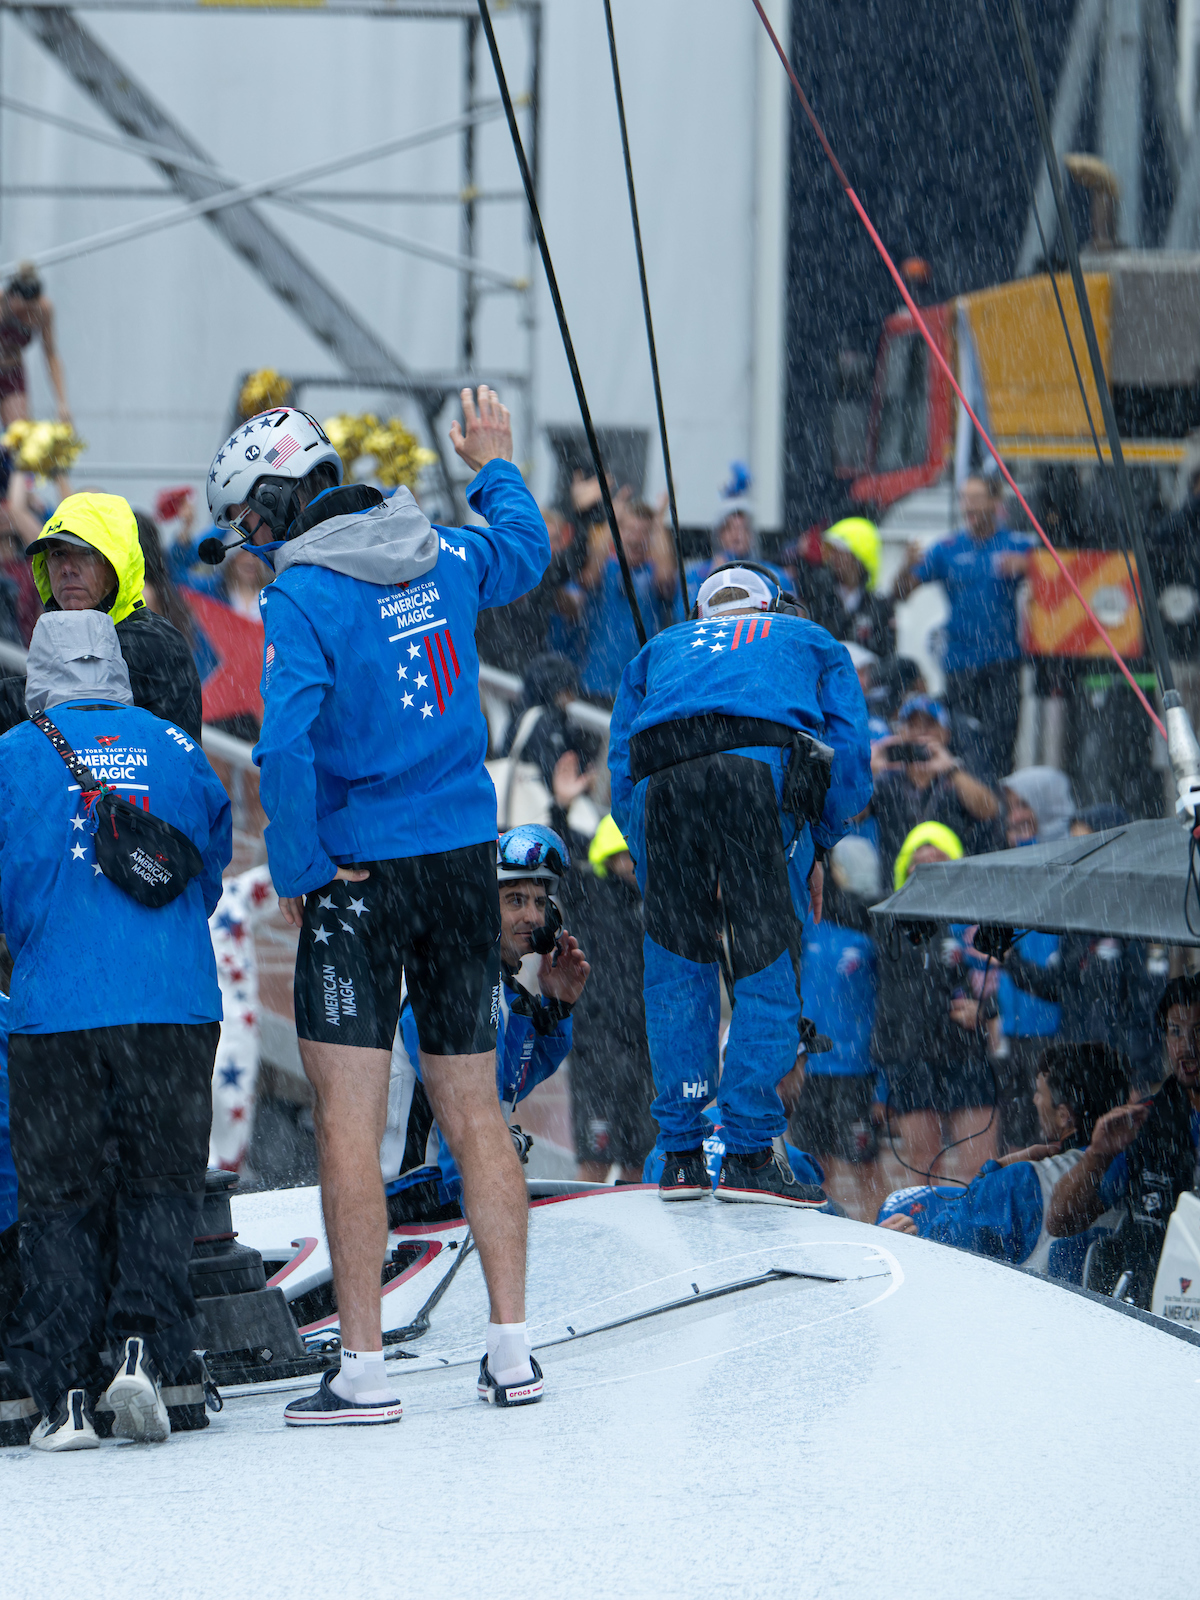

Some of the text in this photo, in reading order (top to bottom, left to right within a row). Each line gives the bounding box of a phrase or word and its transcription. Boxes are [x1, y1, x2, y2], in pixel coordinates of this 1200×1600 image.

[246, 445, 260, 460] 14
[391, 592, 405, 600] YORK
[405, 586, 420, 595] YACHT
[421, 581, 436, 589] CLUB
[380, 588, 440, 619] AMERICAN
[396, 605, 435, 629] MAGIC
[165, 727, 195, 753] HH
[77, 754, 148, 767] MERICAN
[130, 851, 171, 885] AMERICAN
[131, 863, 158, 886] MAGIC
[323, 965, 340, 1026] AMERICAN
[339, 977, 357, 1016] MAGIC
[682, 1080, 709, 1098] HH
[509, 1389, 531, 1397] crocs
